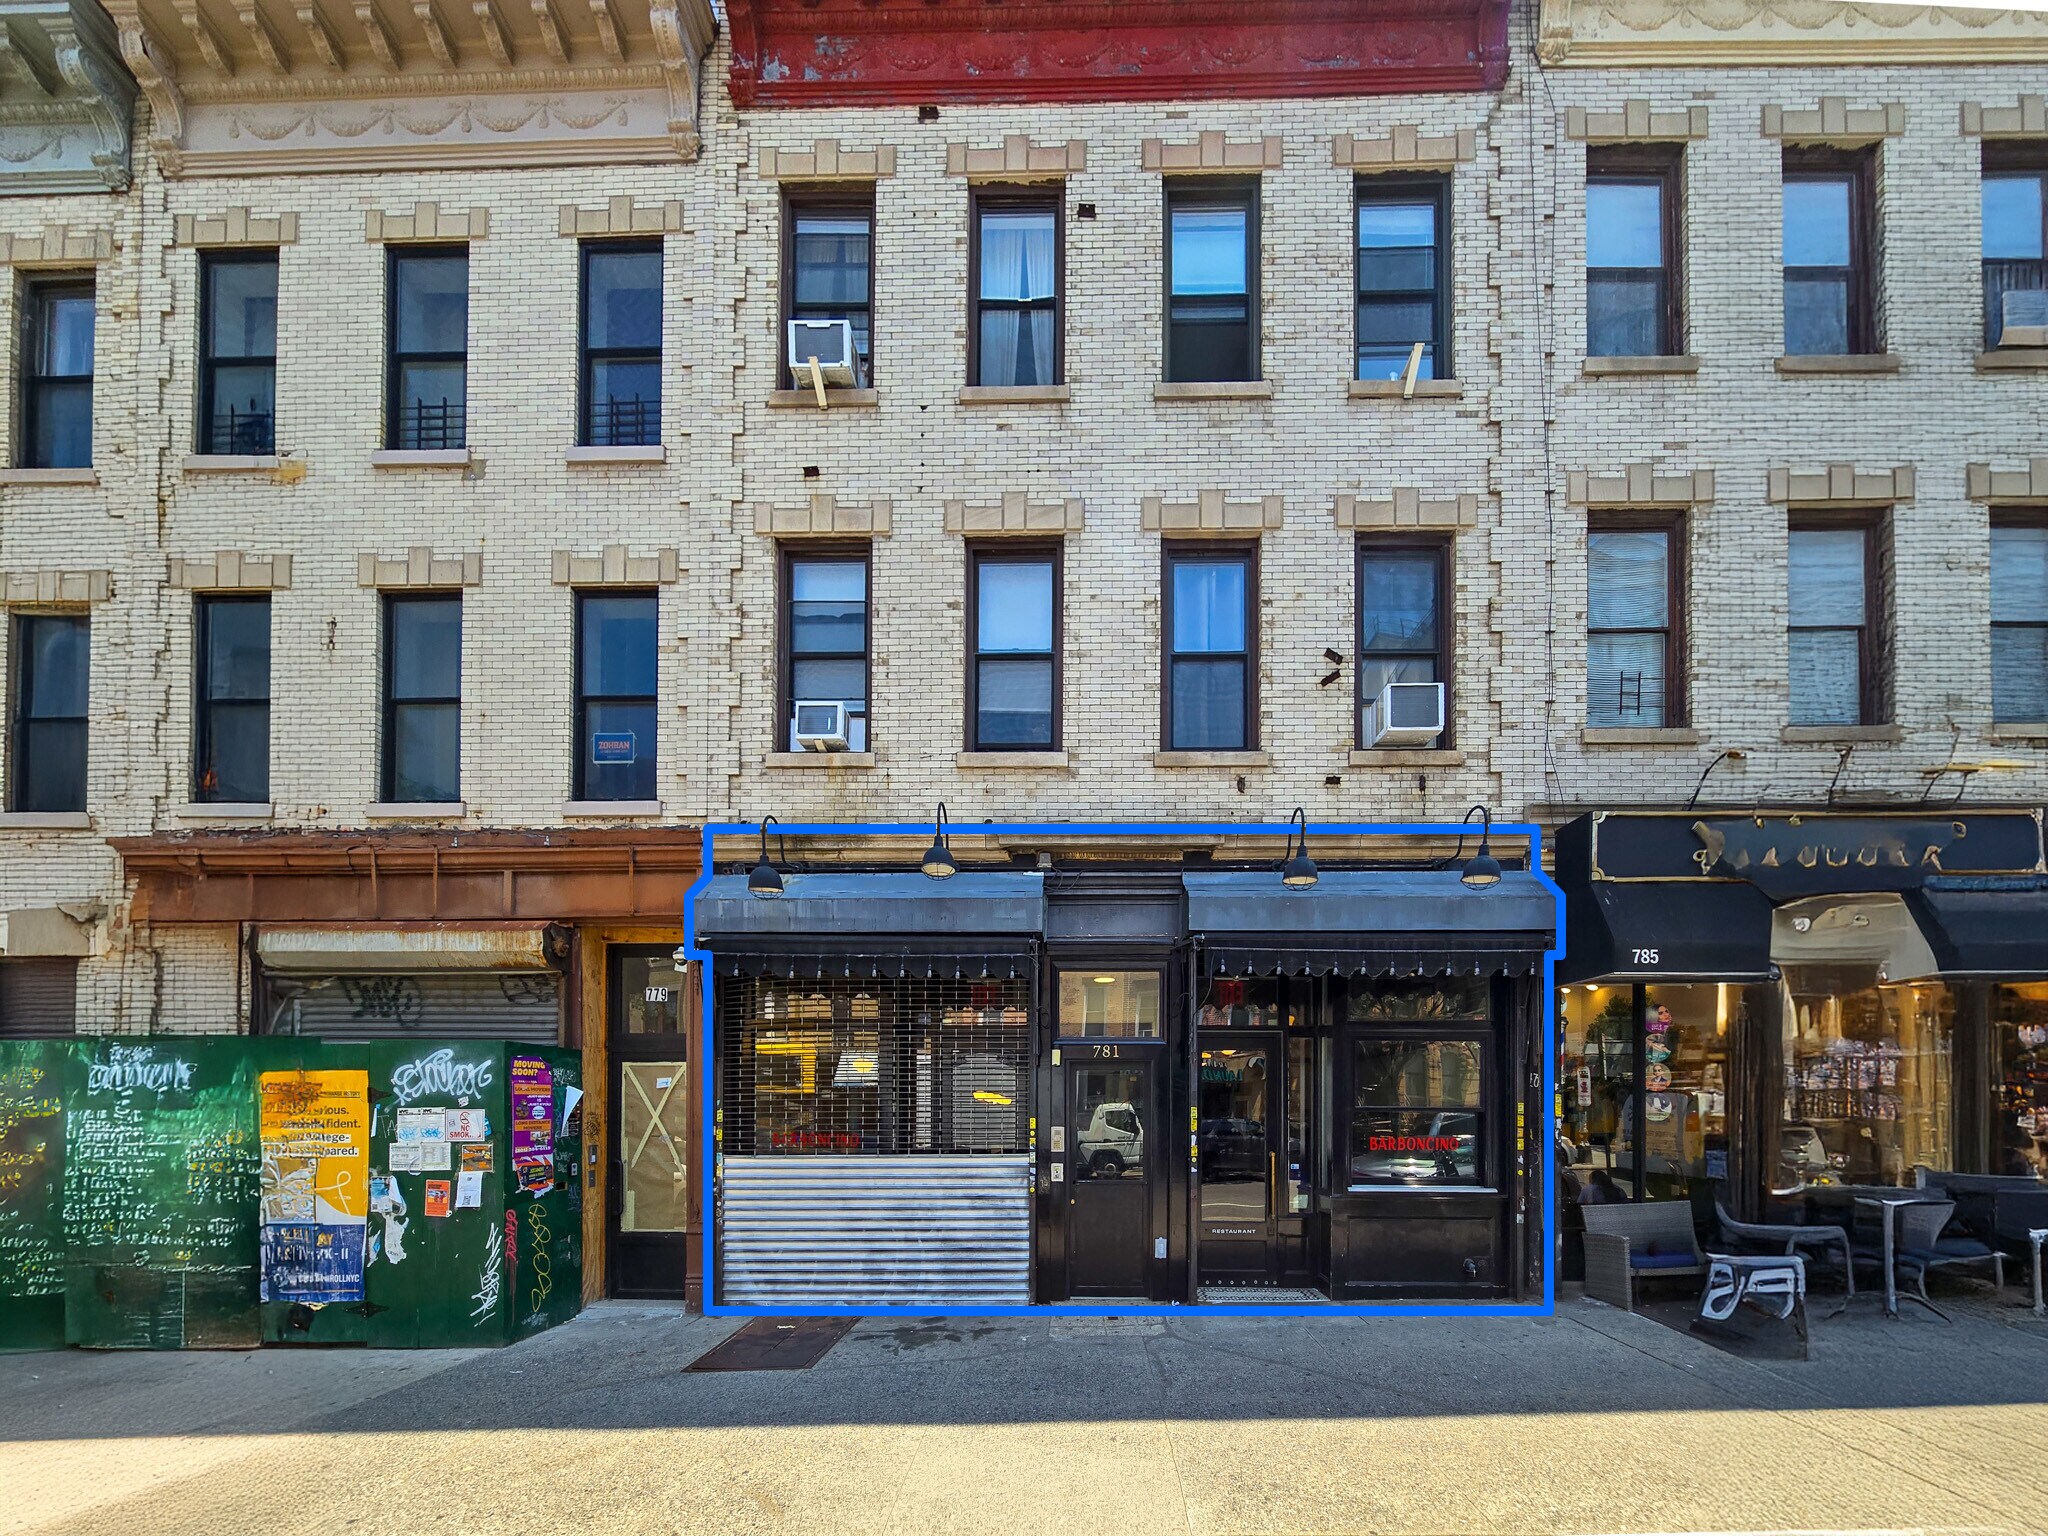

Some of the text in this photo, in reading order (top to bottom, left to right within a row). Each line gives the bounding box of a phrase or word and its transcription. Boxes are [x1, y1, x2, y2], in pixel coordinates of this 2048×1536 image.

[598, 741, 630, 750] ZOHRAN
[1632, 949, 1659, 964] 785
[647, 988, 667, 1001] 779
[1093, 1045, 1119, 1058] 781
[513, 1060, 546, 1069] MOVING
[1369, 1136, 1459, 1151] BARBONCINO
